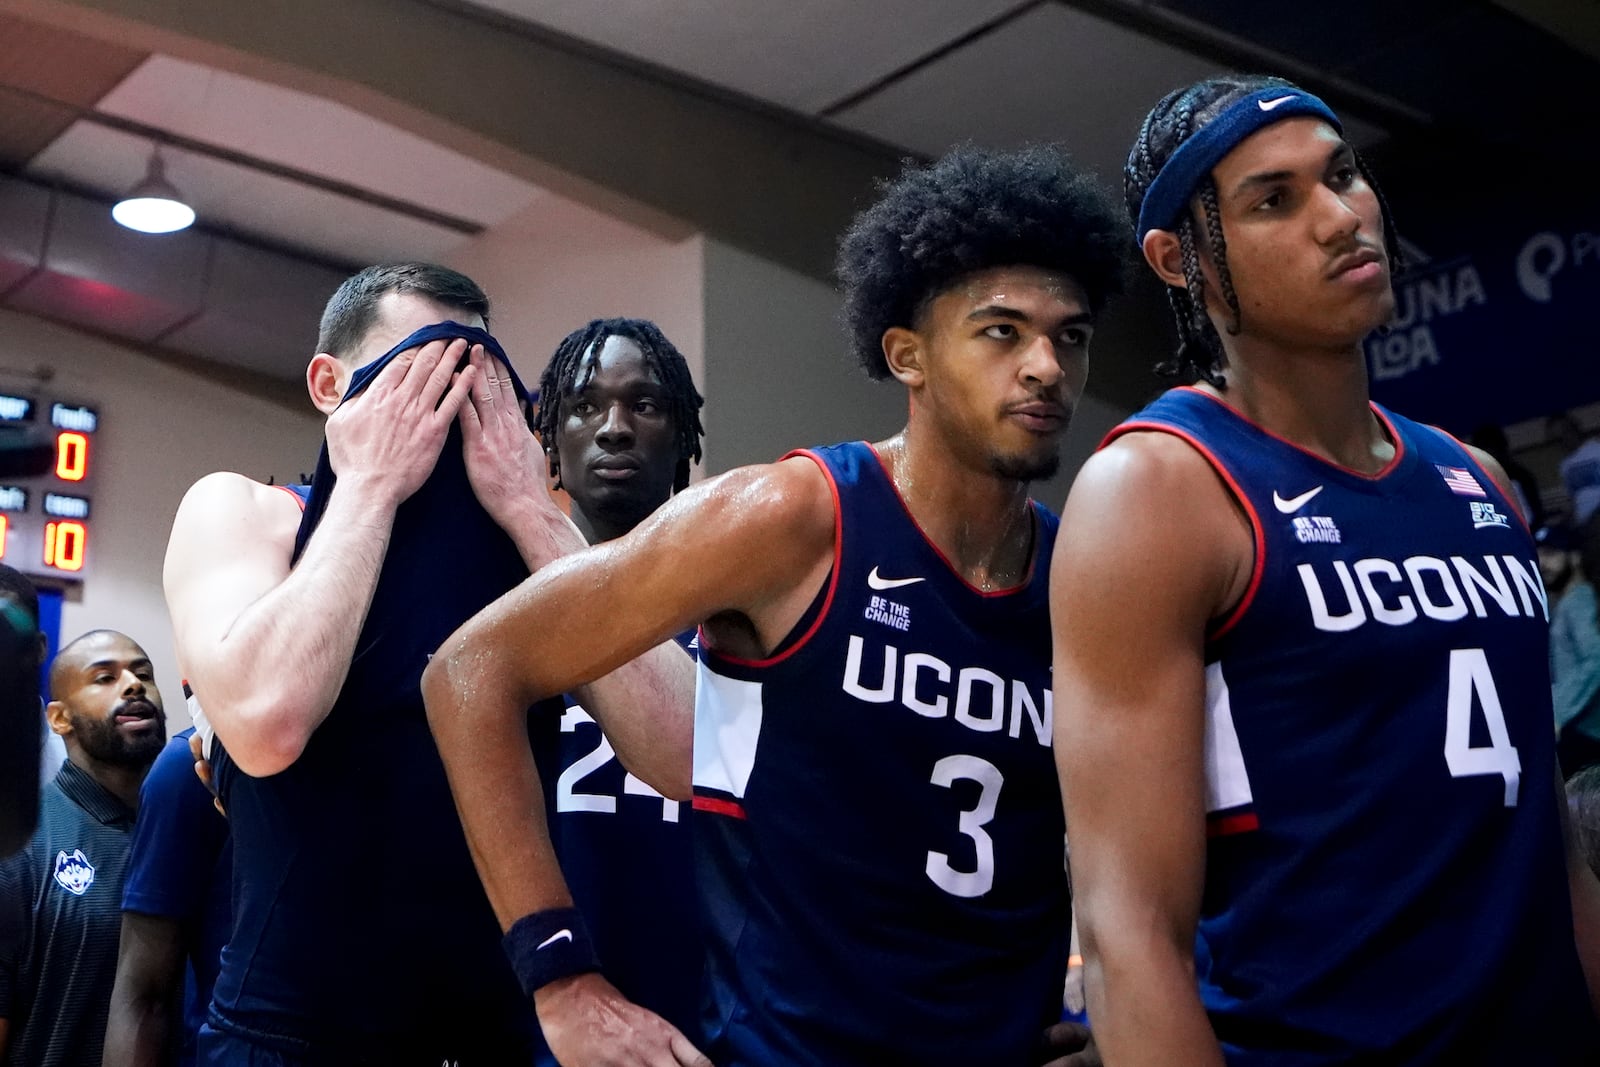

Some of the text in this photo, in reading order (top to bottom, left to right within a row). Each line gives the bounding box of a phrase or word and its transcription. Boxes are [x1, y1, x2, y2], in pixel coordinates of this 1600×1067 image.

[1380, 264, 1487, 335] UNA
[1370, 325, 1440, 381] LOA
[56, 432, 87, 481] 0
[1293, 516, 1336, 529] BE THE
[1296, 528, 1341, 544] CHANGE
[1472, 510, 1508, 524] EAST
[44, 520, 86, 572] 10
[870, 596, 910, 619] BE THE
[1297, 555, 1549, 632] UCONN
[865, 607, 911, 631] CHANGE
[1445, 648, 1521, 807] 4
[925, 754, 1004, 898] 3
